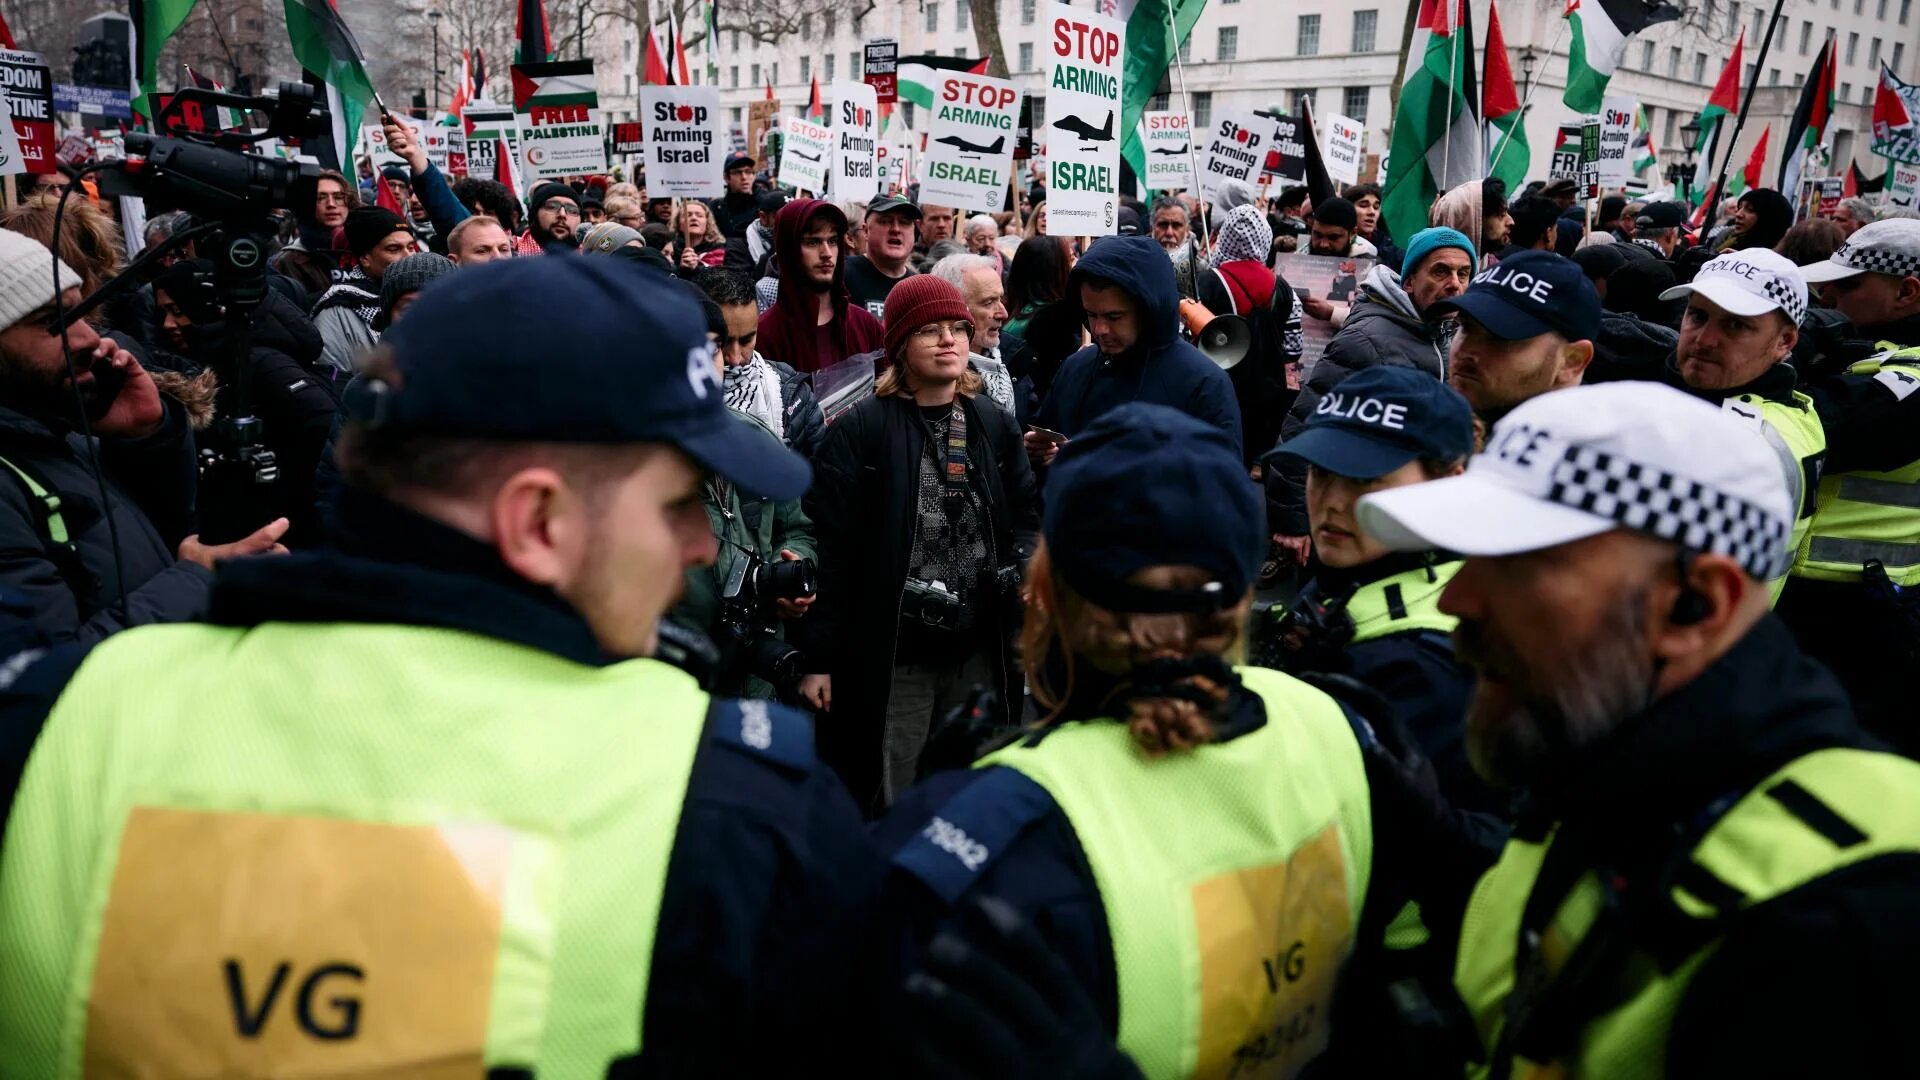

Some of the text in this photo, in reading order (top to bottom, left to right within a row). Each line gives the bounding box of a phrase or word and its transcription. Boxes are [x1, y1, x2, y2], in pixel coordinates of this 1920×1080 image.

[867, 45, 895, 58] FREEDOM
[1053, 18, 1119, 67] STOP
[7, 52, 36, 63] Worker
[865, 61, 896, 74] PALESTINE
[1052, 64, 1117, 100] ARMING
[943, 79, 1016, 109] STOP
[530, 104, 590, 126] FREE
[654, 101, 707, 125] Stop
[843, 100, 872, 132] Stop
[938, 105, 1012, 130] ARMING
[1605, 109, 1631, 128] Stop
[522, 125, 600, 140] PALESTINE
[652, 127, 713, 146] Arming
[791, 121, 827, 140] STOP
[1150, 131, 1191, 140] ARMING
[1219, 120, 1261, 148] Stop
[1333, 123, 1357, 142] Stop
[1601, 130, 1629, 145] Arming
[789, 134, 825, 151] ARMING
[841, 131, 874, 157] Arming
[1330, 137, 1357, 153] Arming
[657, 146, 710, 163] Israel
[1209, 140, 1258, 167] Arming
[1331, 148, 1355, 164] Israel
[1600, 146, 1626, 159] Israel
[784, 160, 820, 179] ISRAEL
[844, 156, 873, 178] Israel
[928, 161, 1002, 187] ISRAEL
[1150, 163, 1191, 173] ISRAEL
[1207, 156, 1250, 181] Israel
[1052, 161, 1114, 193] ISRAEL
[1895, 171, 1918, 184] STOP
[1261, 940, 1304, 993] VG
[222, 958, 367, 1042] VG
